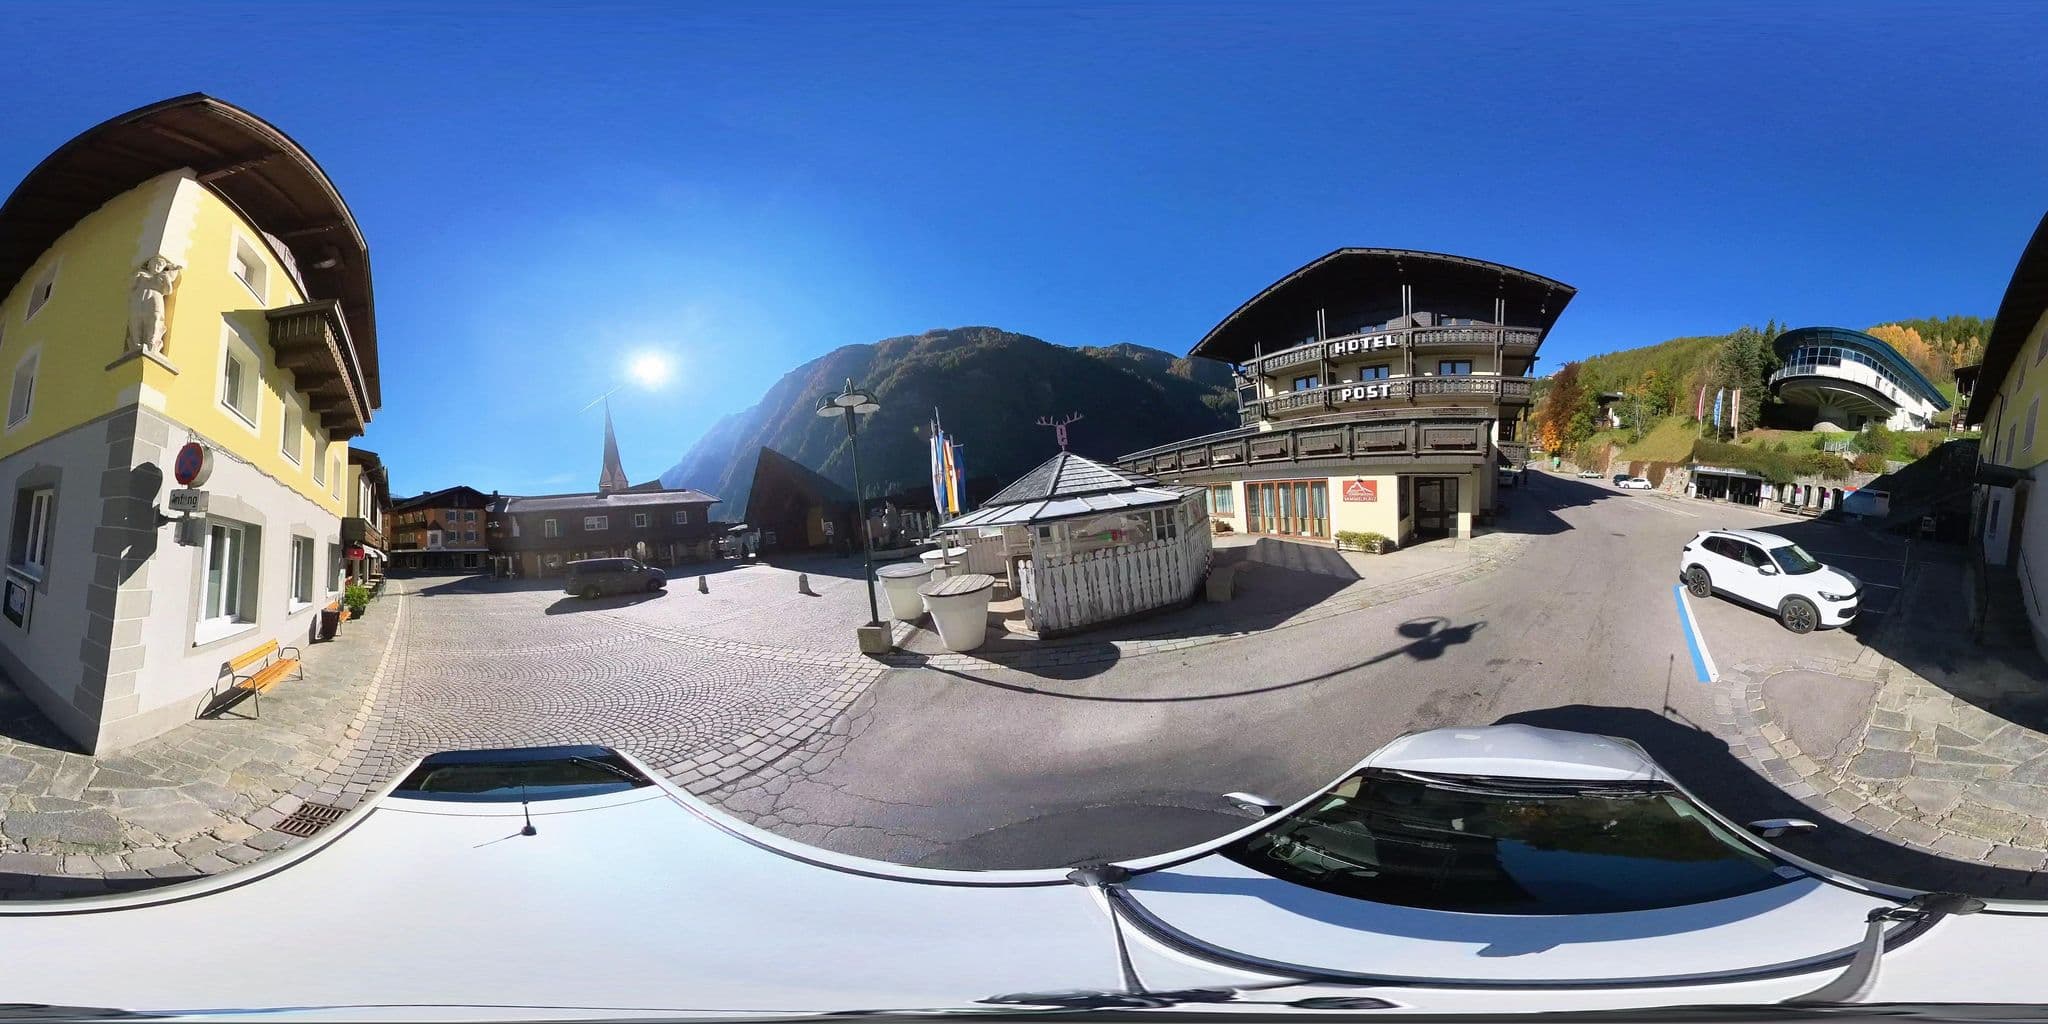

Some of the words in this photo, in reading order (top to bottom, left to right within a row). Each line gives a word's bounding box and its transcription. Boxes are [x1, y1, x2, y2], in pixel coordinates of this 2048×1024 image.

[1335, 335, 1396, 353] HOTEL
[1342, 384, 1391, 400] POST
[171, 494, 198, 508] nfng
